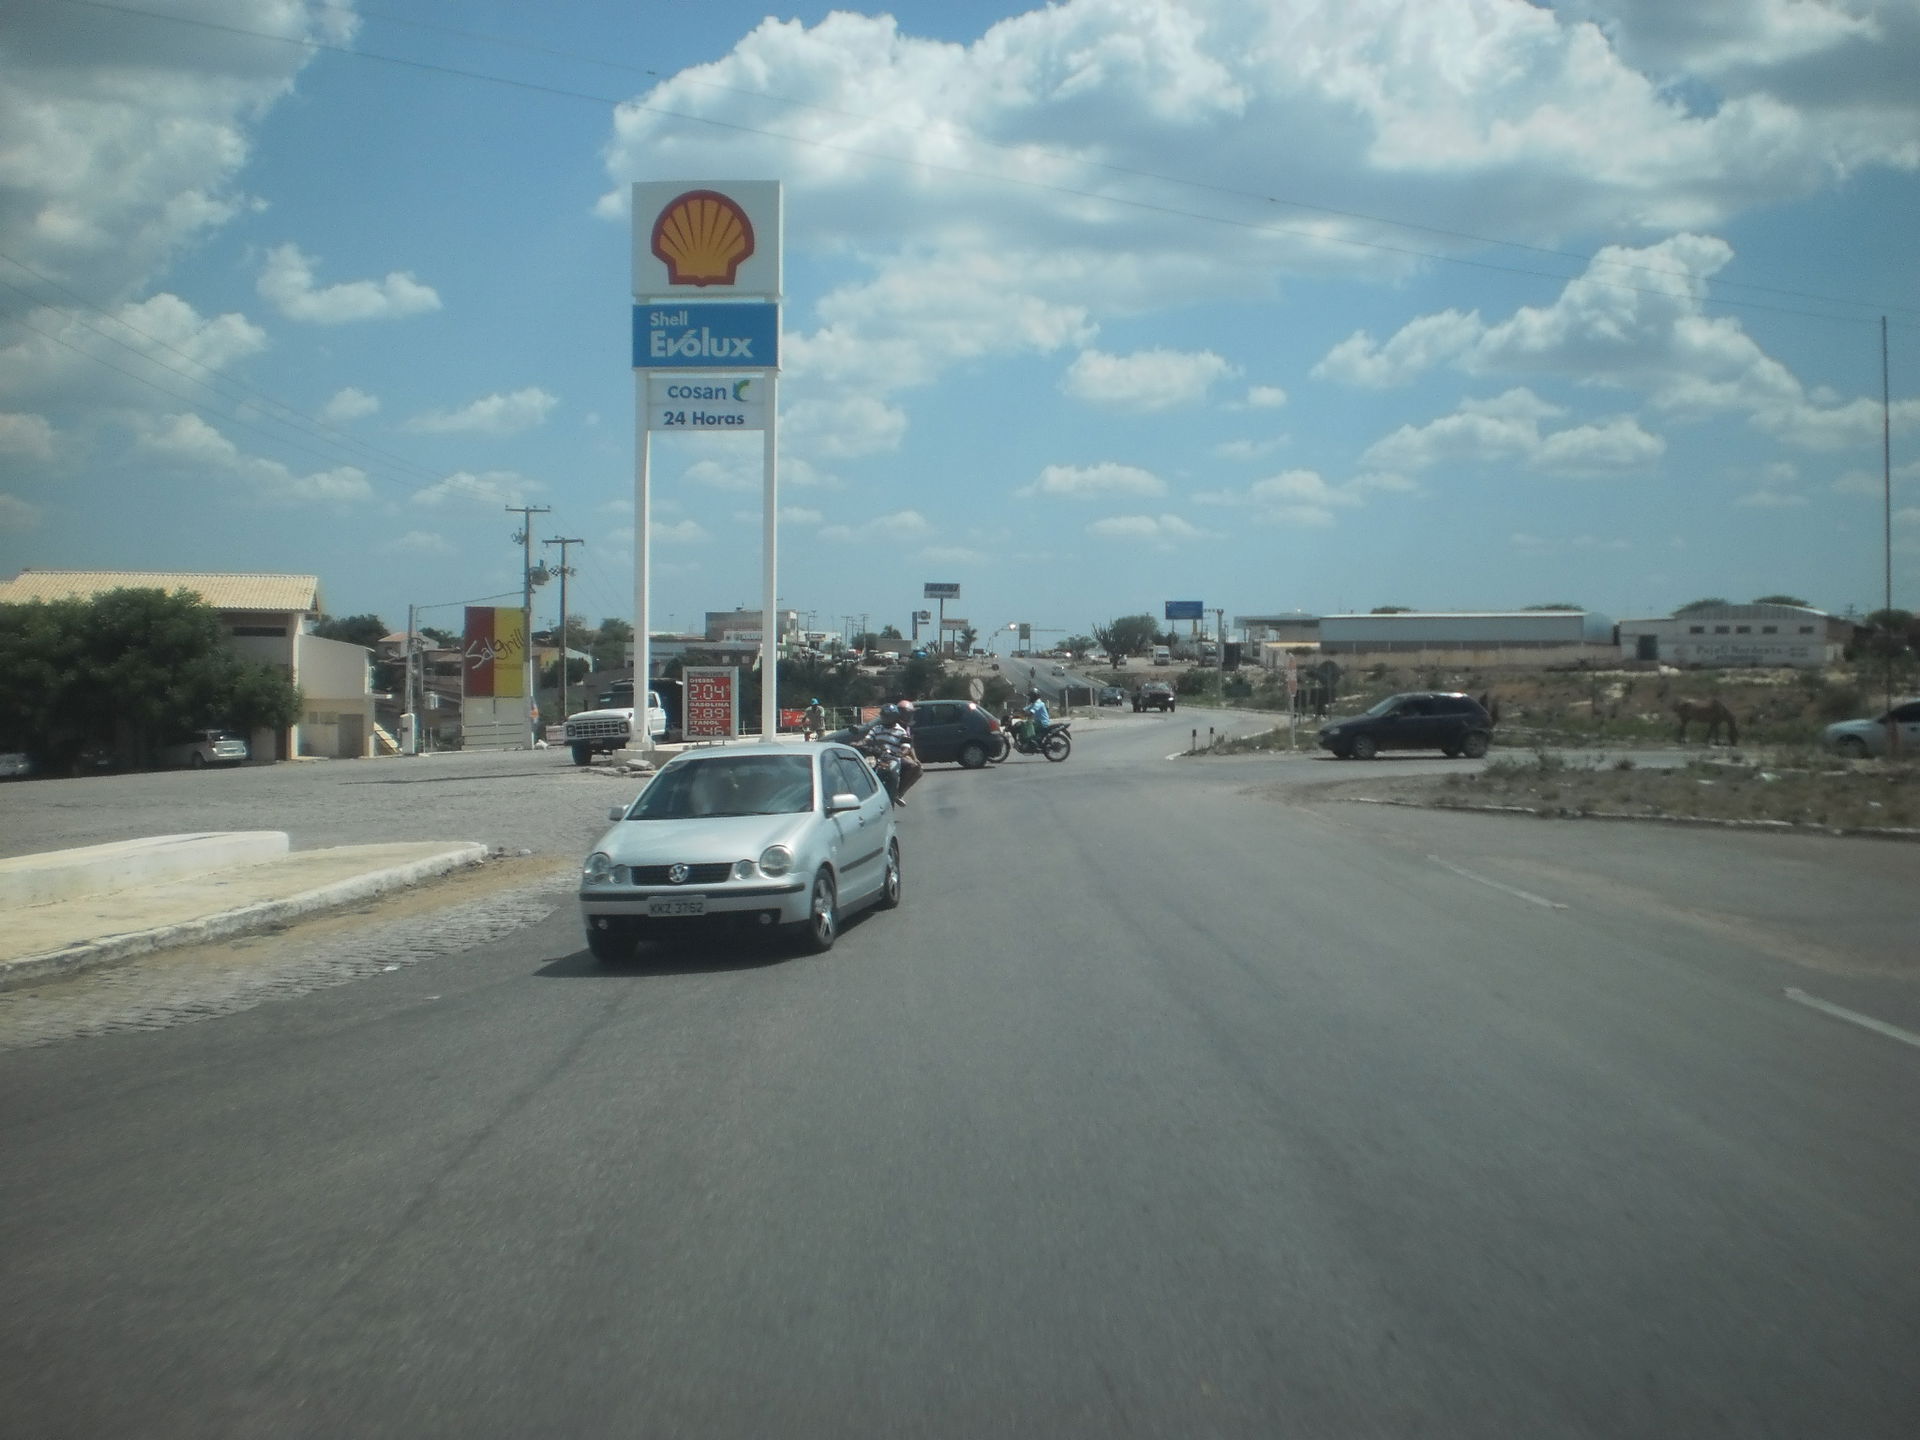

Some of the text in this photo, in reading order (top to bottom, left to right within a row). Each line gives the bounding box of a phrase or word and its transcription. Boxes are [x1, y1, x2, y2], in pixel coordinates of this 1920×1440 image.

[650, 311, 688, 326] Shell
[667, 385, 727, 400] cosan
[663, 411, 745, 425] 24 Horas
